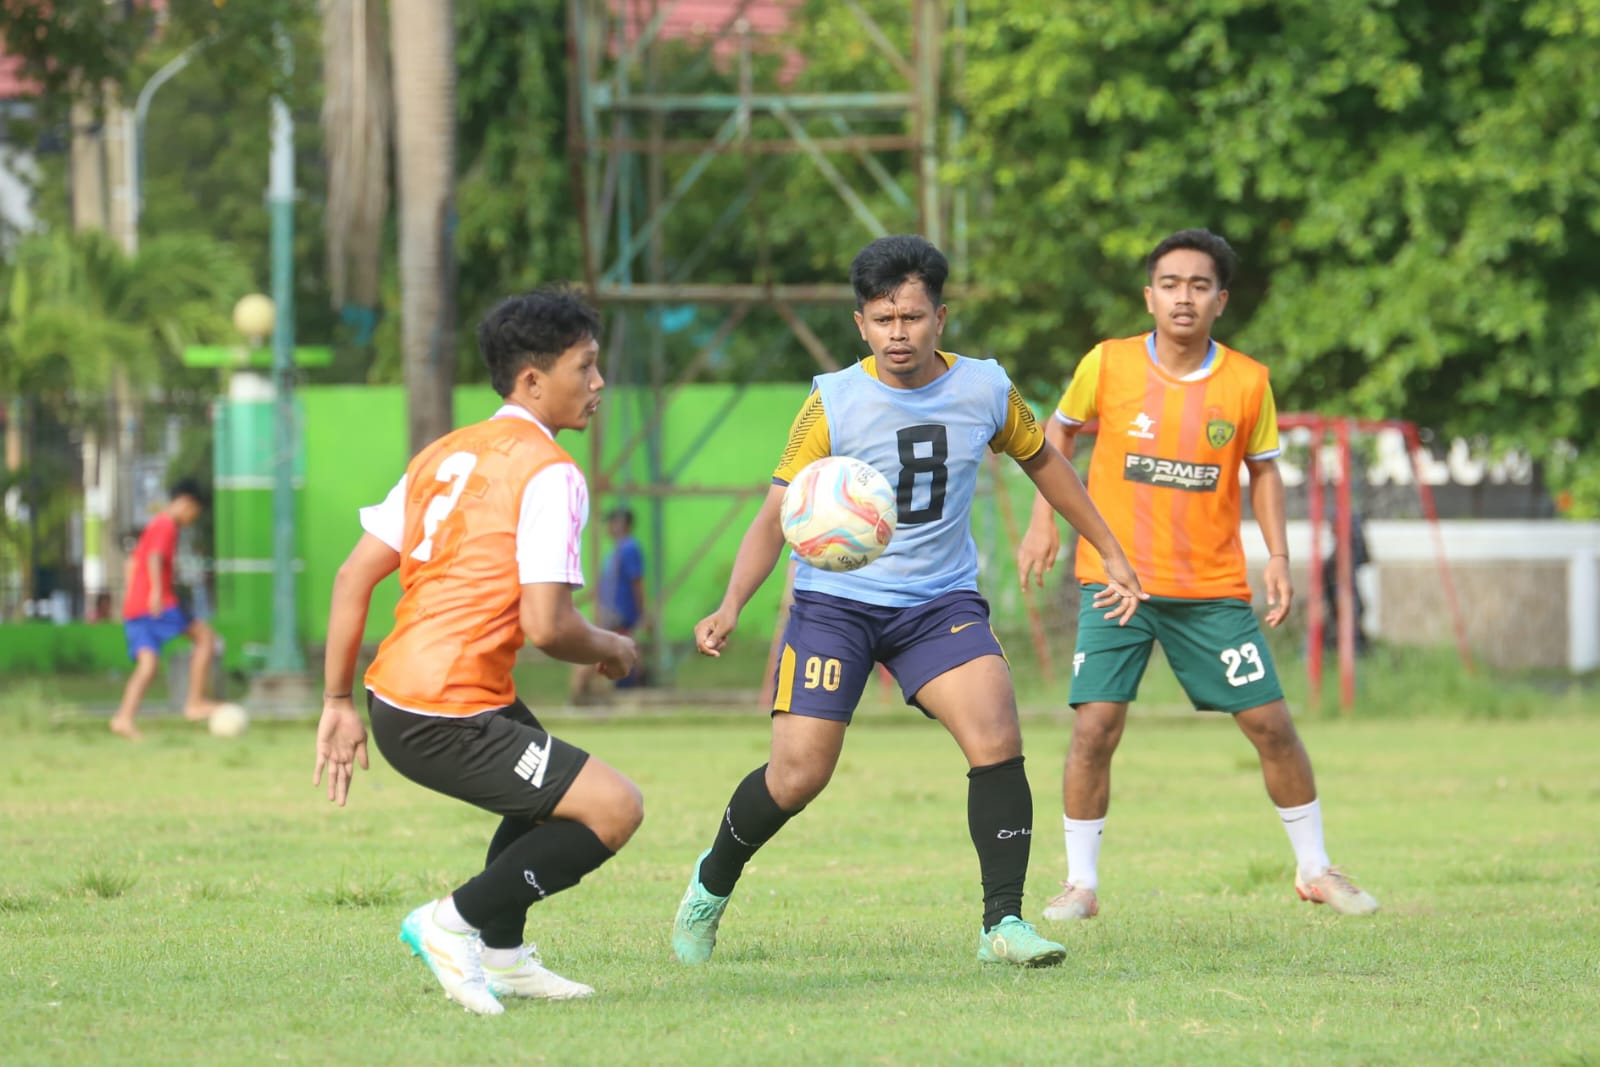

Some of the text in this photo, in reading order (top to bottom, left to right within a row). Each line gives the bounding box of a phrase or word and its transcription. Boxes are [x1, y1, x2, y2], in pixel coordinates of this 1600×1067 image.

[896, 424, 949, 524] 8
[1126, 455, 1220, 479] FORMER
[804, 656, 841, 692] 90
[1220, 642, 1265, 687] 23
